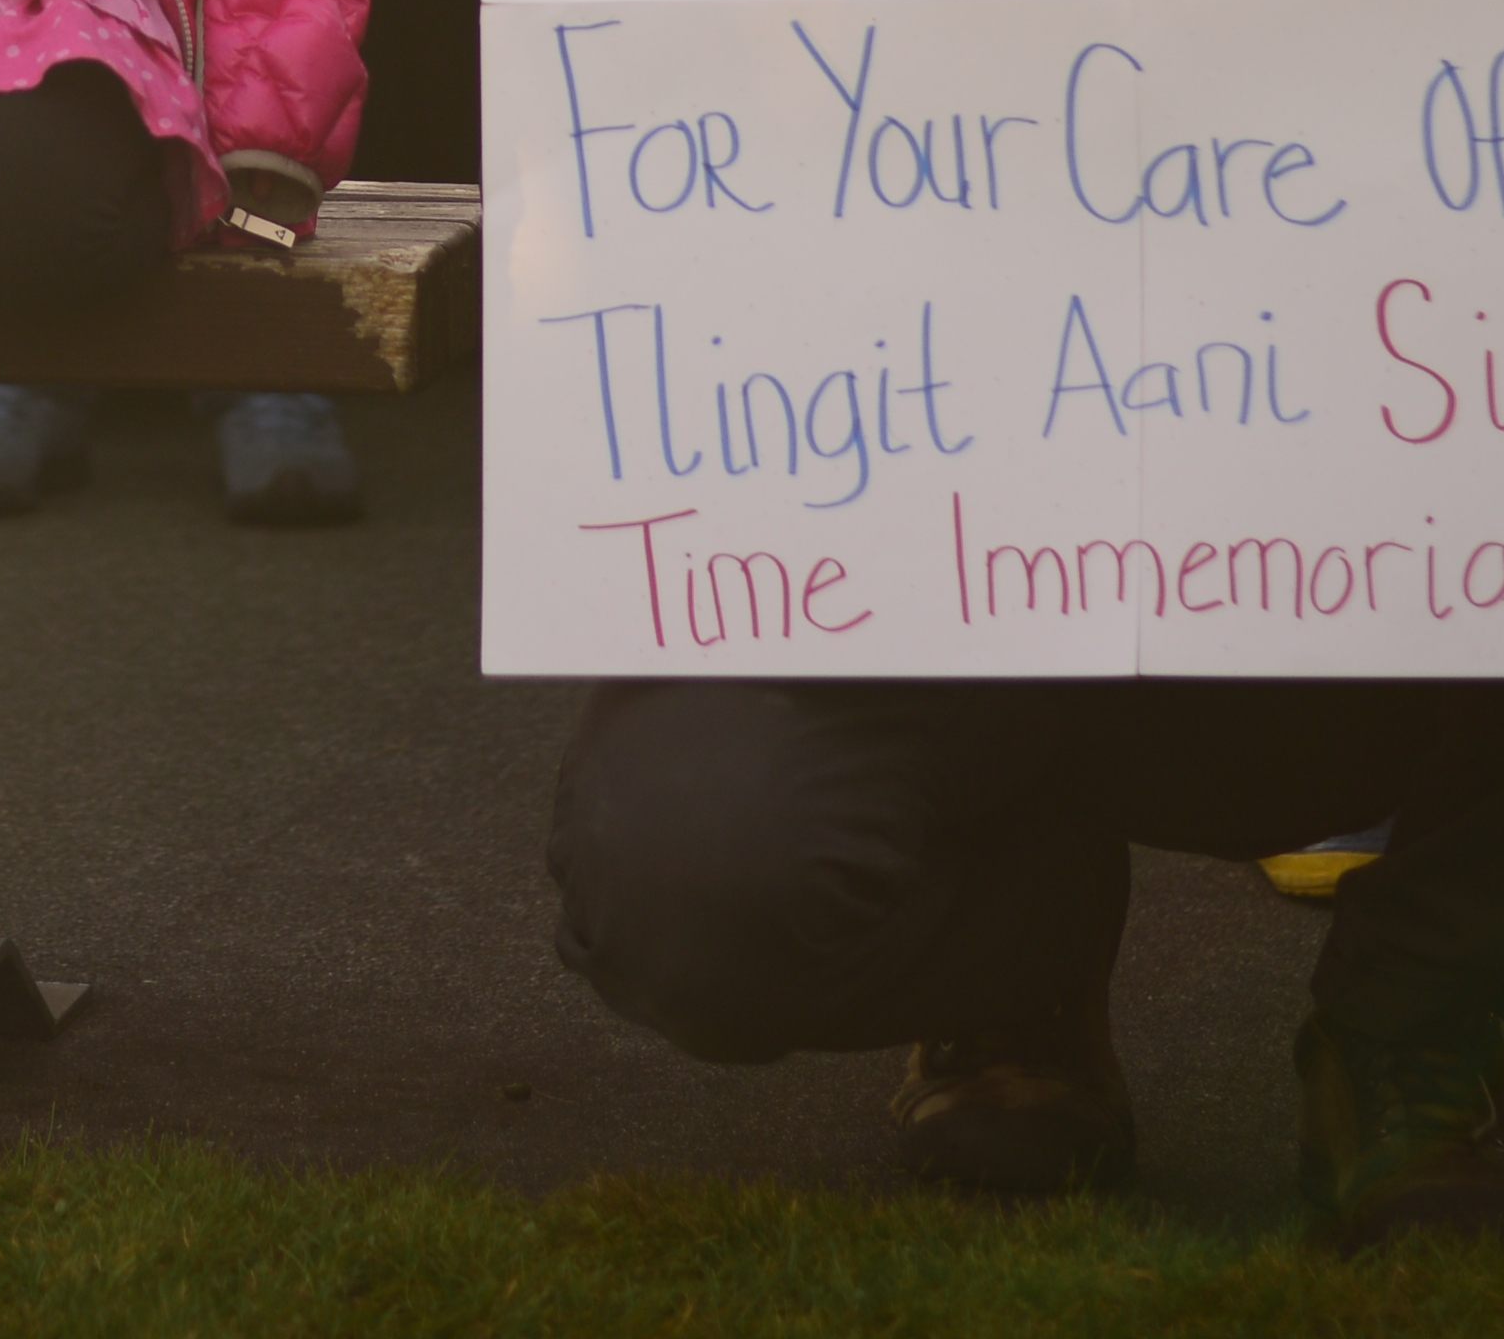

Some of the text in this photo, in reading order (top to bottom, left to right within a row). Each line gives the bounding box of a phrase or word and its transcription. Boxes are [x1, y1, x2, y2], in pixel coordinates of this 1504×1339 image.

[791, 20, 1038, 220] Your
[1066, 42, 1348, 227] Care
[538, 302, 974, 509] Tlingit
[1043, 295, 1310, 437] Aani
[579, 507, 874, 648] Time
